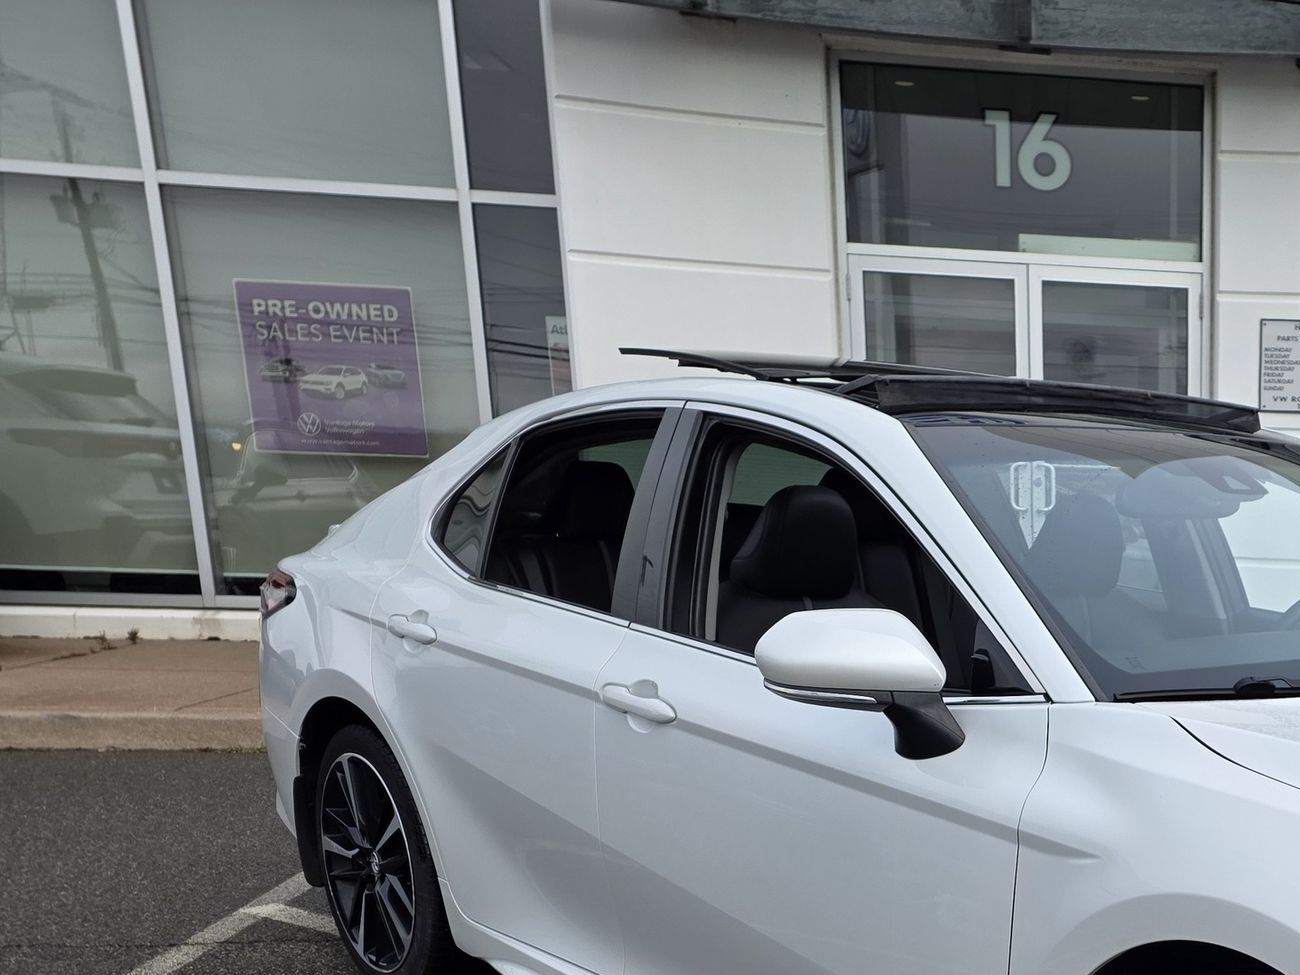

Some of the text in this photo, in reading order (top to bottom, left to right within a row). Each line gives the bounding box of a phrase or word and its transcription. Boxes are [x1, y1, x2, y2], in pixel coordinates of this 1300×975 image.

[984, 109, 1072, 191] 16
[252, 298, 399, 322] PRE-OWNED
[256, 321, 400, 345] SALES EVENT
